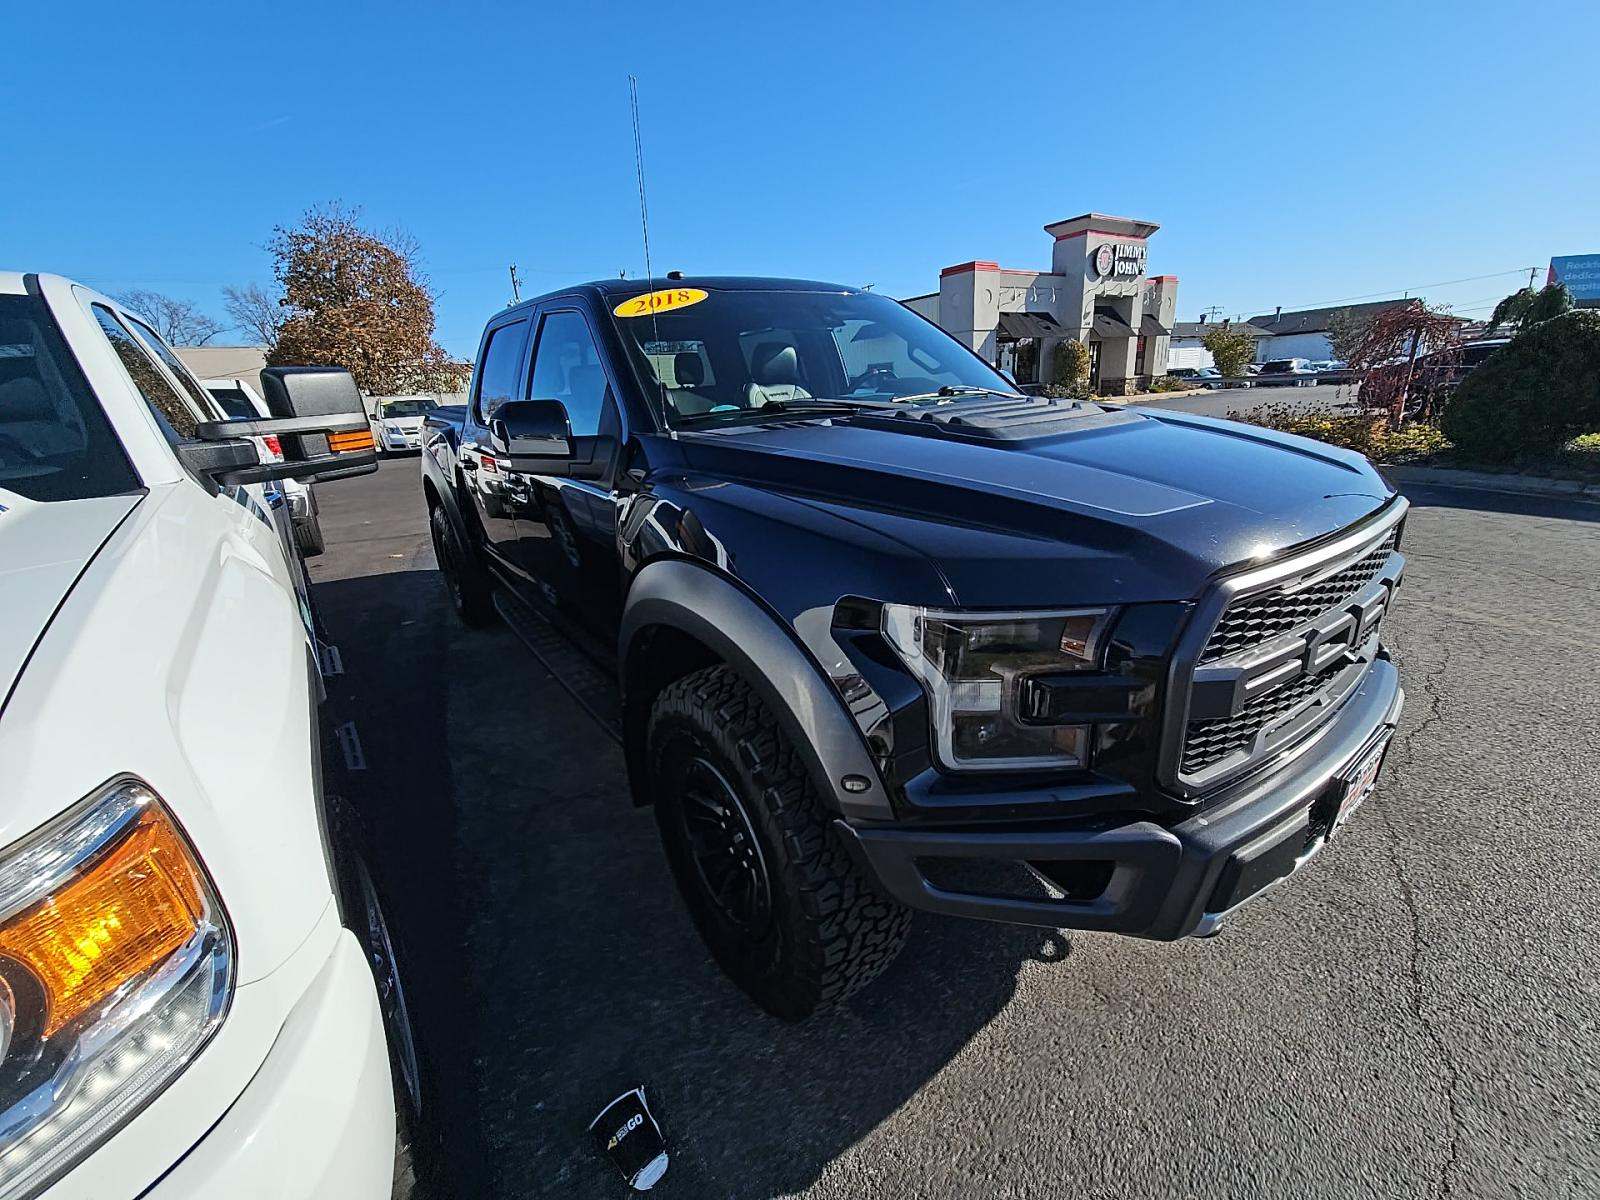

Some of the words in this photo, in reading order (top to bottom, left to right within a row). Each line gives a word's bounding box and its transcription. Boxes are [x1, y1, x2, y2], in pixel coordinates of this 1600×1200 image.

[1114, 244, 1147, 260] JIMMY
[1114, 260, 1147, 277] JOHN'S
[634, 290, 690, 313] 2018
